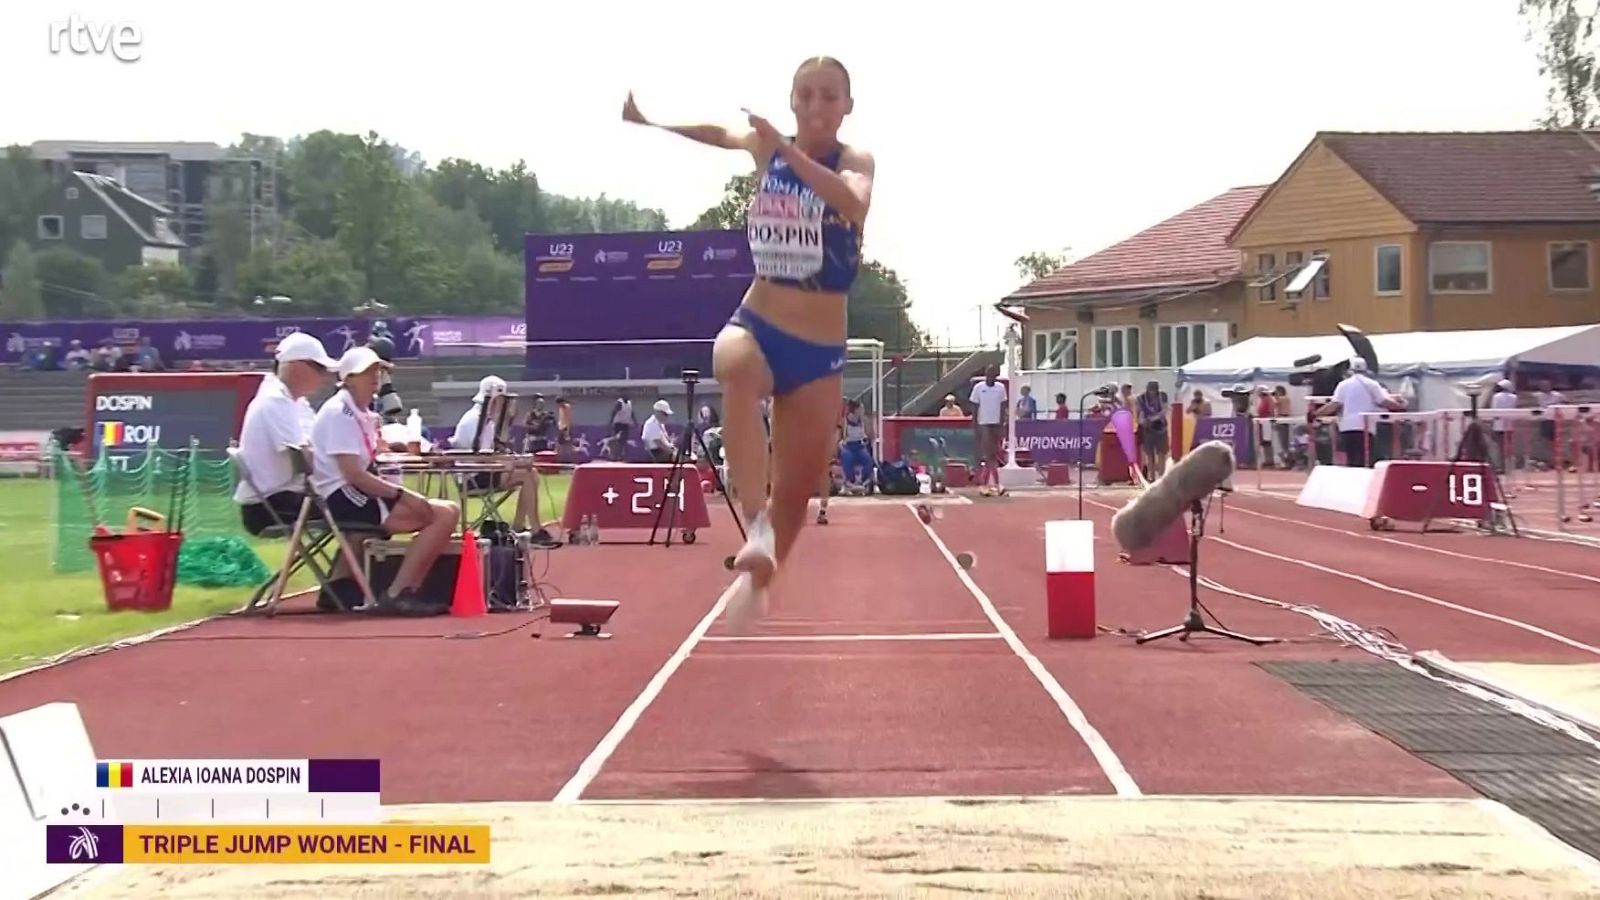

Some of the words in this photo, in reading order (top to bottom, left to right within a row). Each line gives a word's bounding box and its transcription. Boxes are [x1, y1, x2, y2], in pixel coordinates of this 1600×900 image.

[748, 222, 819, 248] DOSPIN
[549, 244, 574, 256] U23
[657, 240, 683, 253] U23
[510, 323, 526, 335] U2
[95, 395, 153, 412] DOSPIN
[123, 425, 161, 444] ROU
[1212, 423, 1236, 437] U23
[1448, 474, 1483, 505] 1.8
